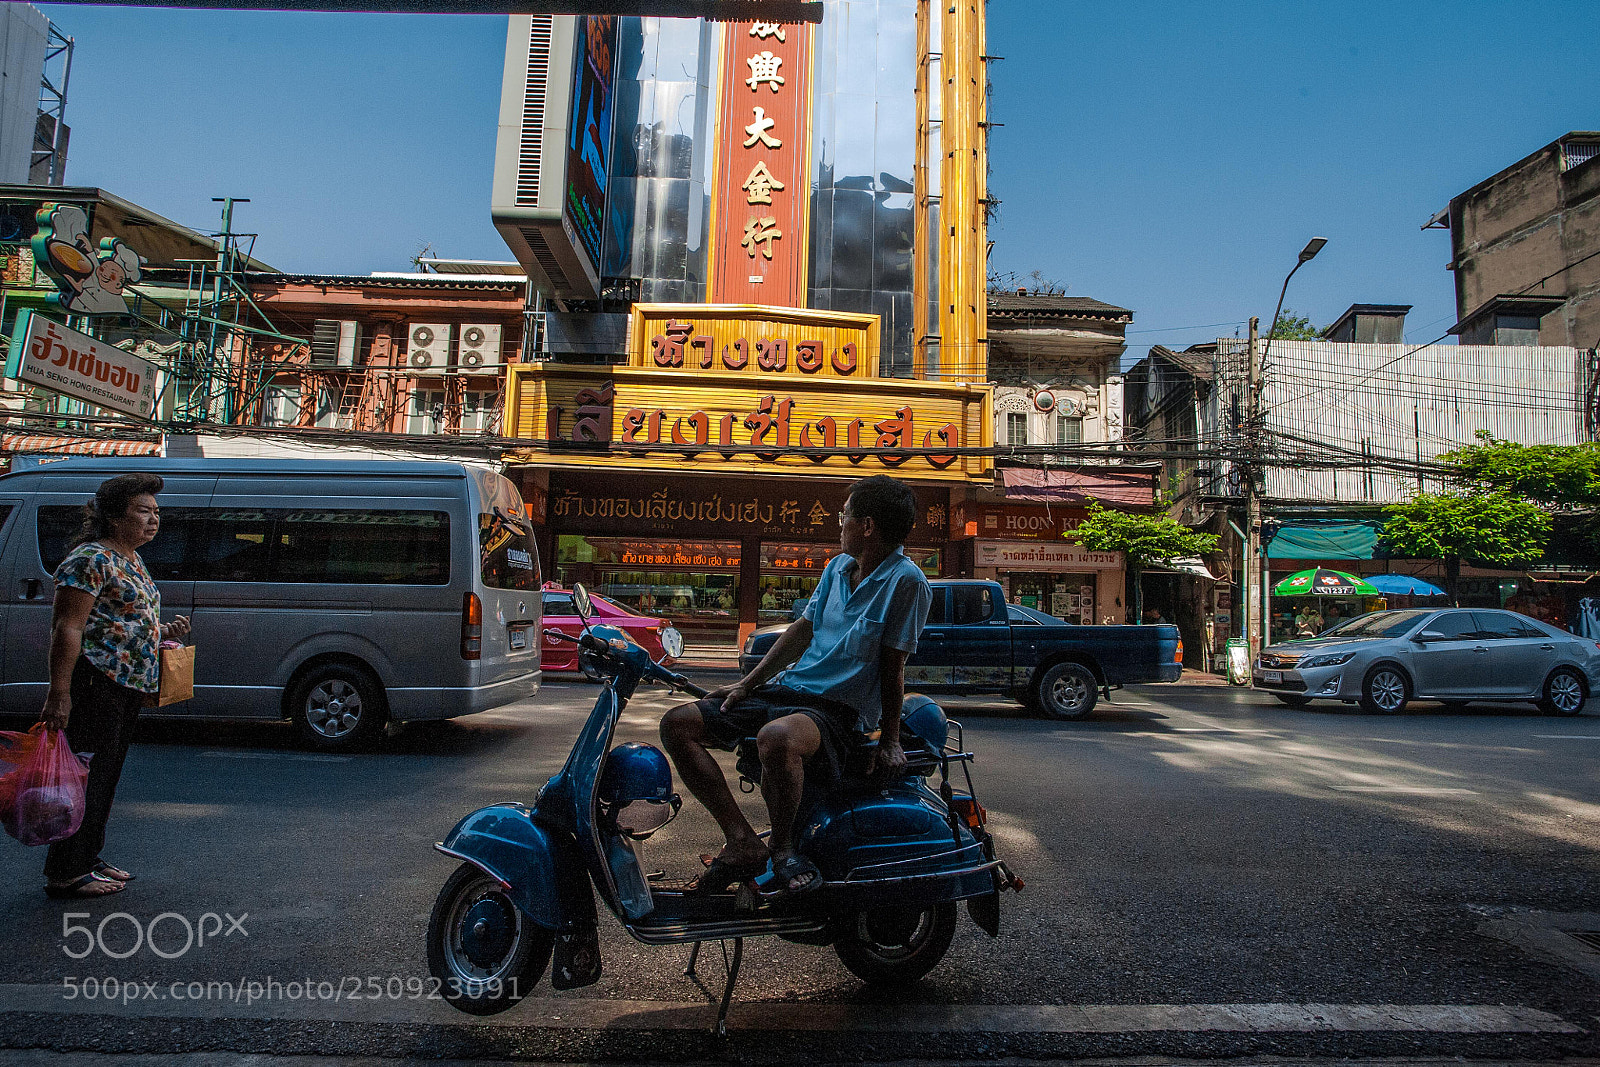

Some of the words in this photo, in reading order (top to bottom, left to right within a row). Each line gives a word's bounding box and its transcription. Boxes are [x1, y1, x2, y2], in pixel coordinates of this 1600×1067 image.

[652, 318, 857, 376] ห้างทอง
[26, 365, 44, 377] HUA
[46, 370, 69, 385] SENG
[70, 377, 91, 395] HONG
[92, 386, 135, 407] RESTAURANT
[1006, 516, 1050, 530] HOON
